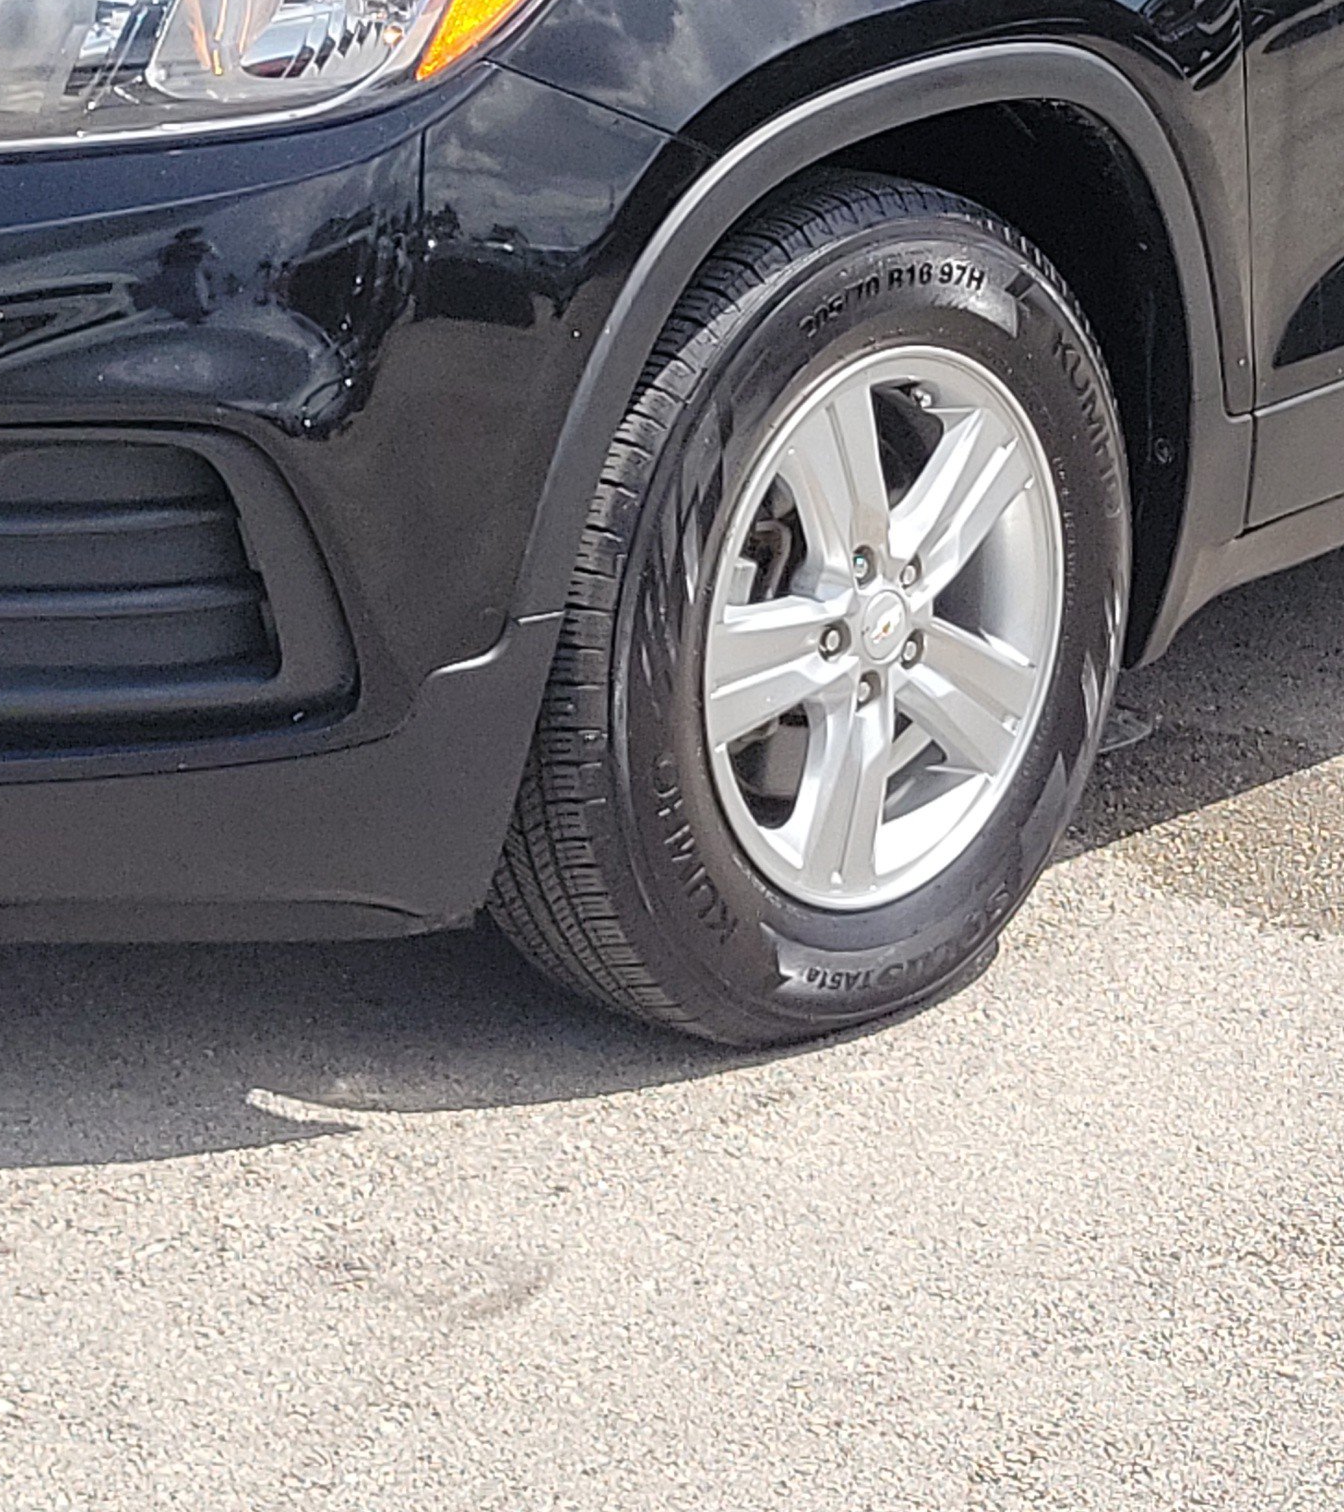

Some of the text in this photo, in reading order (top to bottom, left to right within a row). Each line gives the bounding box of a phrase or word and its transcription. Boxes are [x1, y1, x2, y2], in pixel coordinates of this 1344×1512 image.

[888, 262, 933, 290] R16
[937, 261, 986, 291] 97H
[1053, 330, 1122, 519] KUMHO
[654, 753, 740, 946] KUMHO
